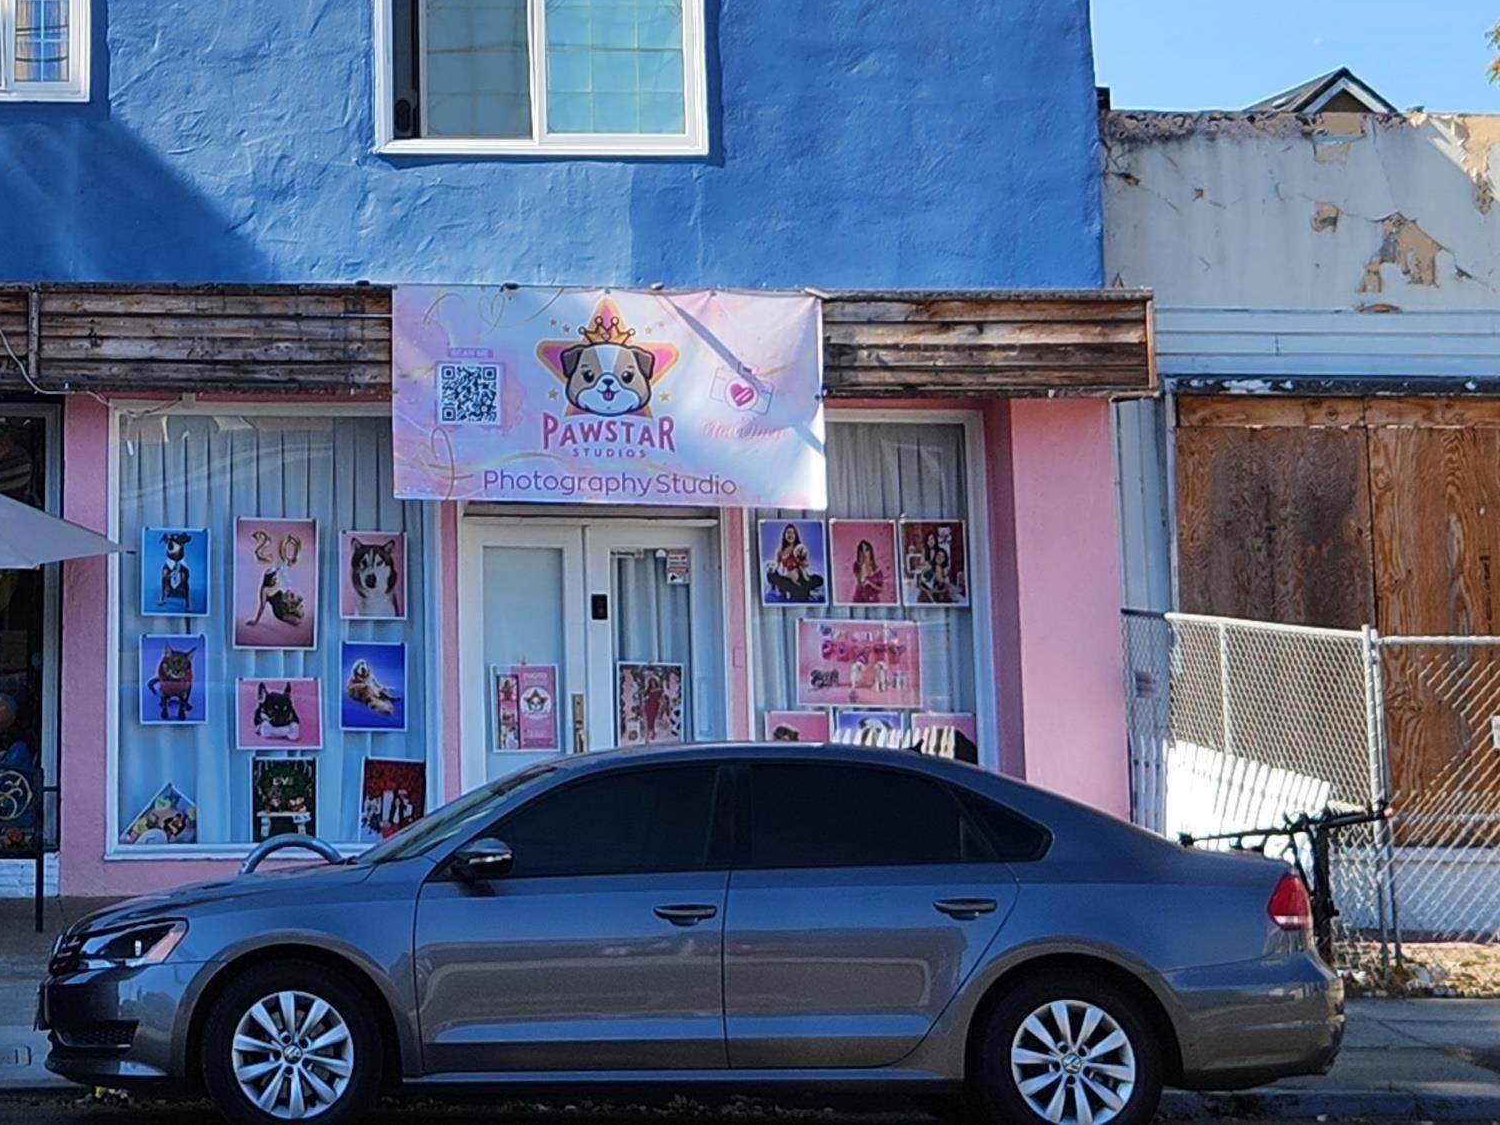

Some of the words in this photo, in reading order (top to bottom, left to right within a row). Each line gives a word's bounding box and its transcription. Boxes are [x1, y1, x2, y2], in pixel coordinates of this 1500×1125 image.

[542, 412, 676, 453] PAWSTAR
[572, 447, 647, 459] STUDIOS
[483, 469, 651, 498] Photography
[655, 473, 737, 496] Studio
